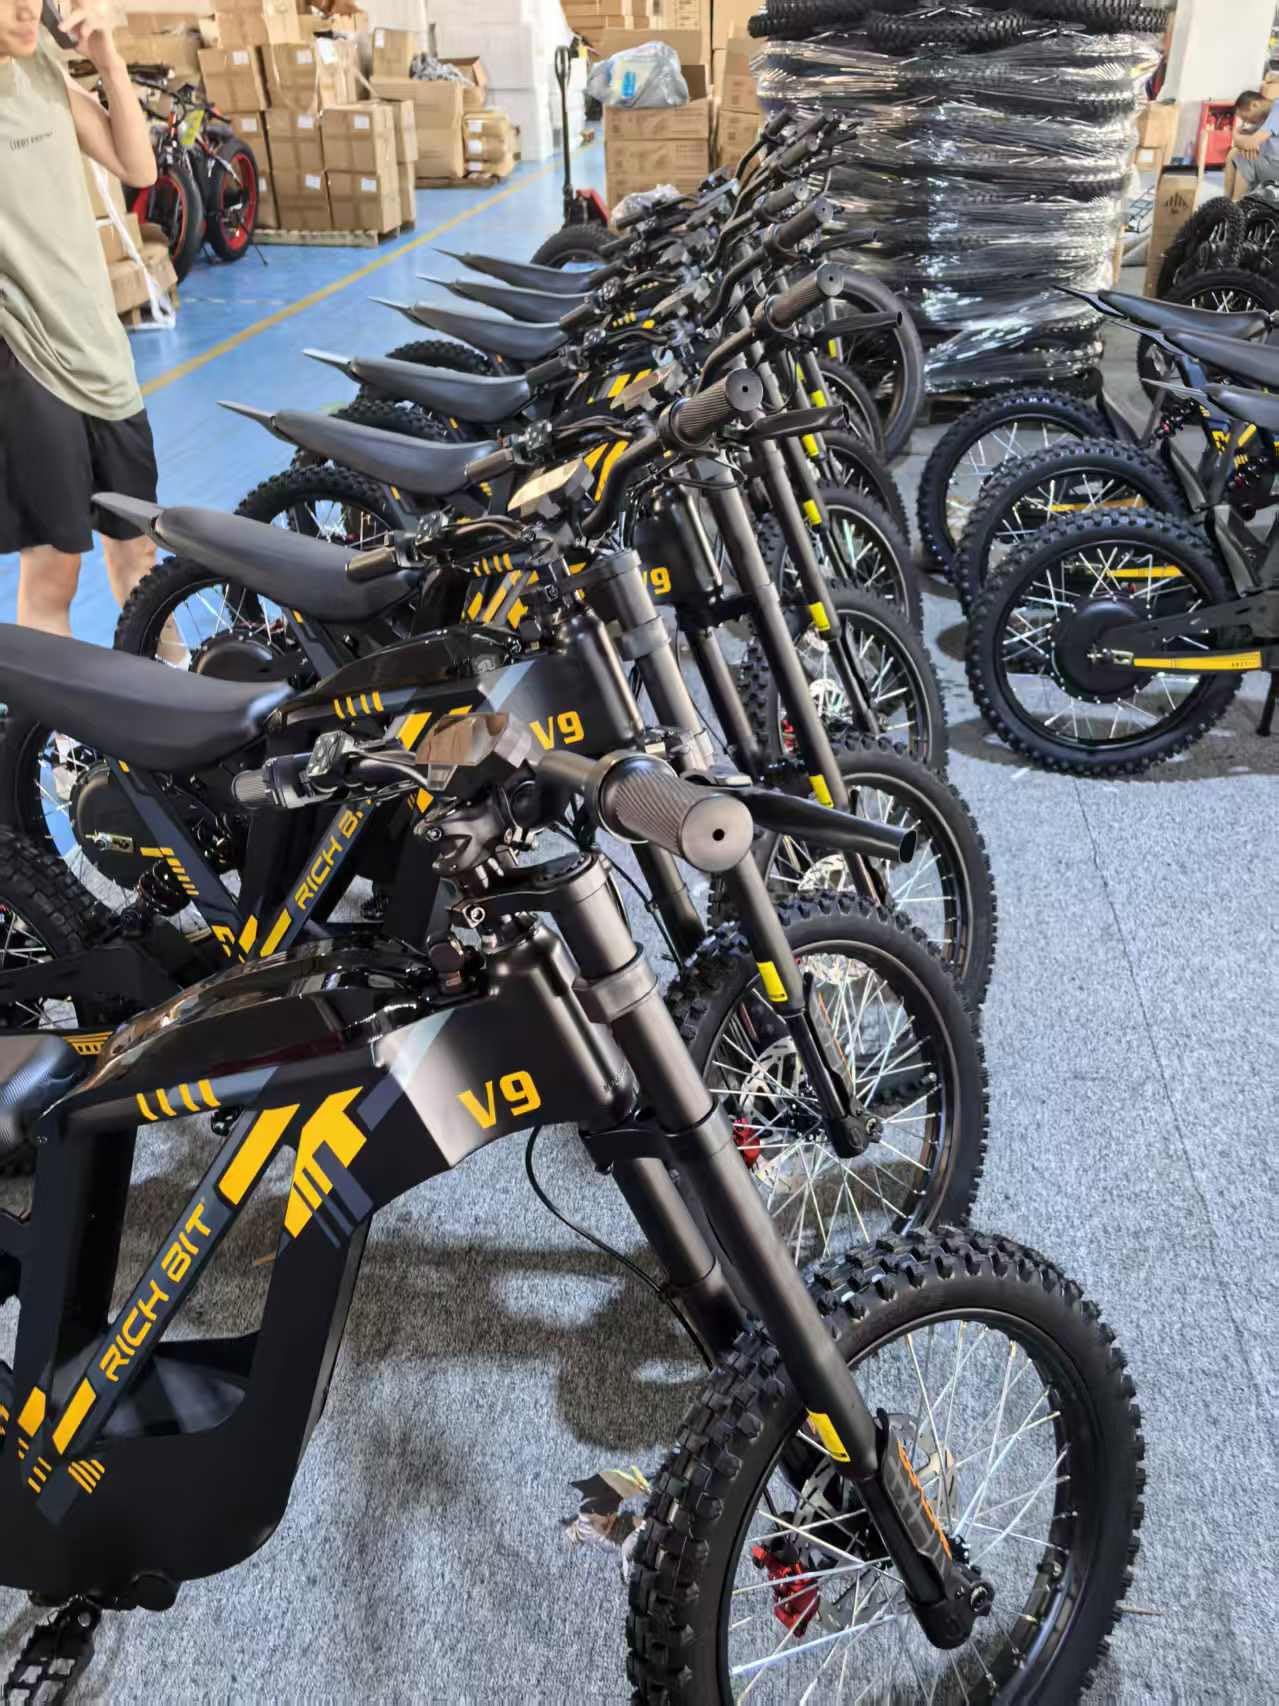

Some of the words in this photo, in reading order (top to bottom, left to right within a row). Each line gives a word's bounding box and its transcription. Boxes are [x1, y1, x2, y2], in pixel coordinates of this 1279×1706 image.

[528, 710, 585, 751] V9
[294, 835, 343, 910] RICH
[456, 1070, 542, 1129] V9
[99, 1280, 170, 1382] RICH
[161, 1201, 212, 1283] BIT
